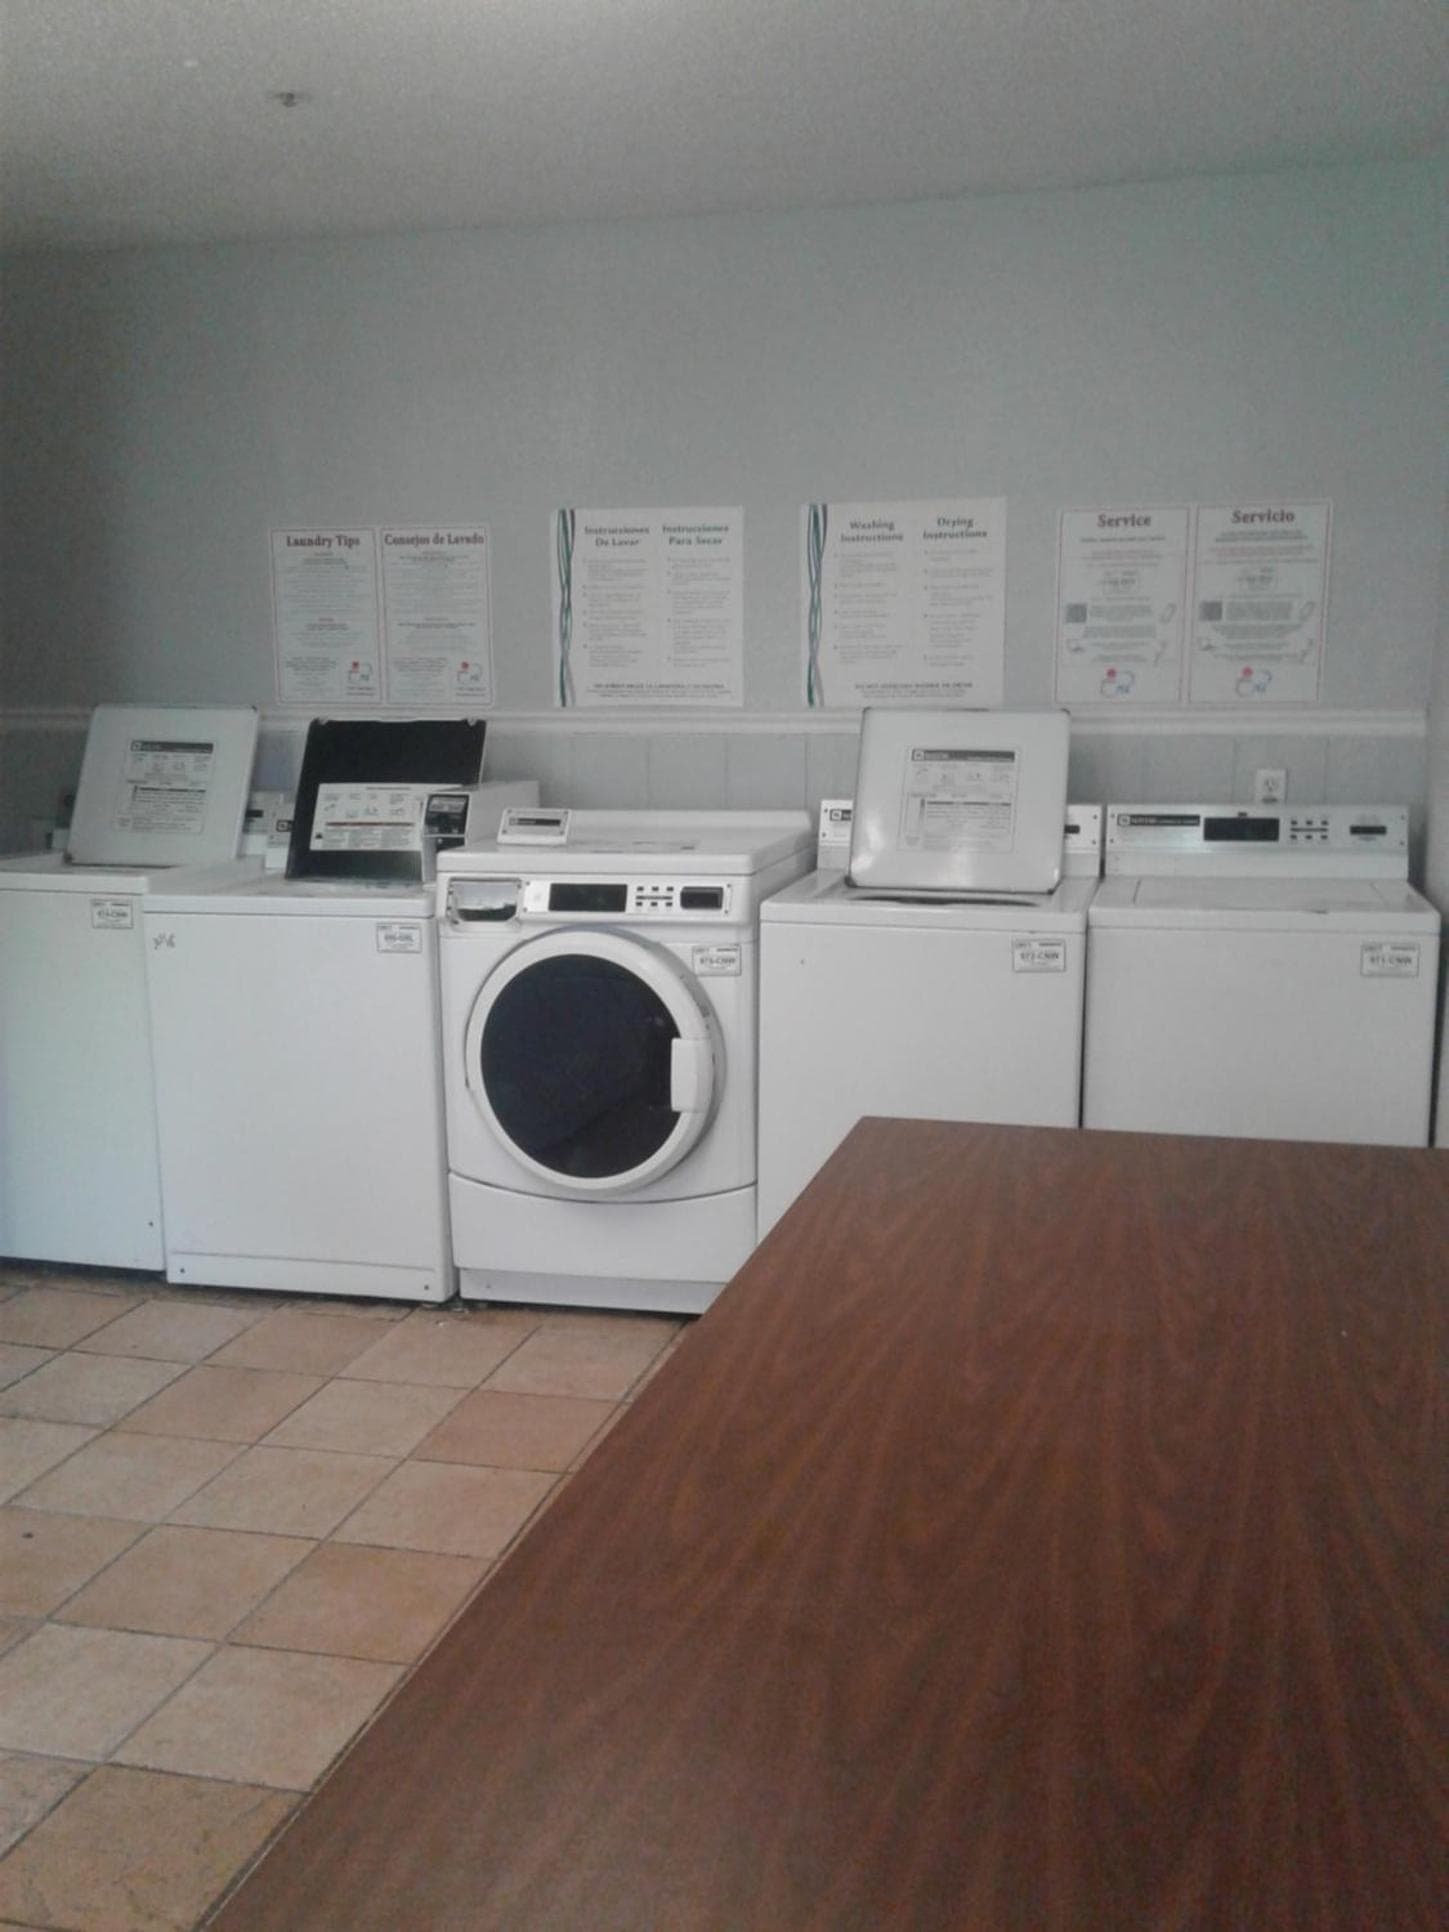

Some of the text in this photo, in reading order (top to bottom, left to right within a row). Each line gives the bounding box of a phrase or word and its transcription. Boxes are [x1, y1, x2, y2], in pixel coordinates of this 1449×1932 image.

[936, 515, 975, 528] Drying
[1096, 513, 1152, 528] Service
[1231, 508, 1296, 524] Servicio
[584, 525, 650, 536] Instrucciones
[661, 523, 729, 535] Instrucciones
[848, 518, 895, 531] Washing
[384, 532, 485, 548] Consejos de Lavado
[668, 536, 723, 546] Para Secar
[839, 532, 904, 544] Instructions
[921, 529, 988, 541] Instructions
[285, 534, 360, 549] Laundry Tips
[611, 537, 640, 547] Lavar
